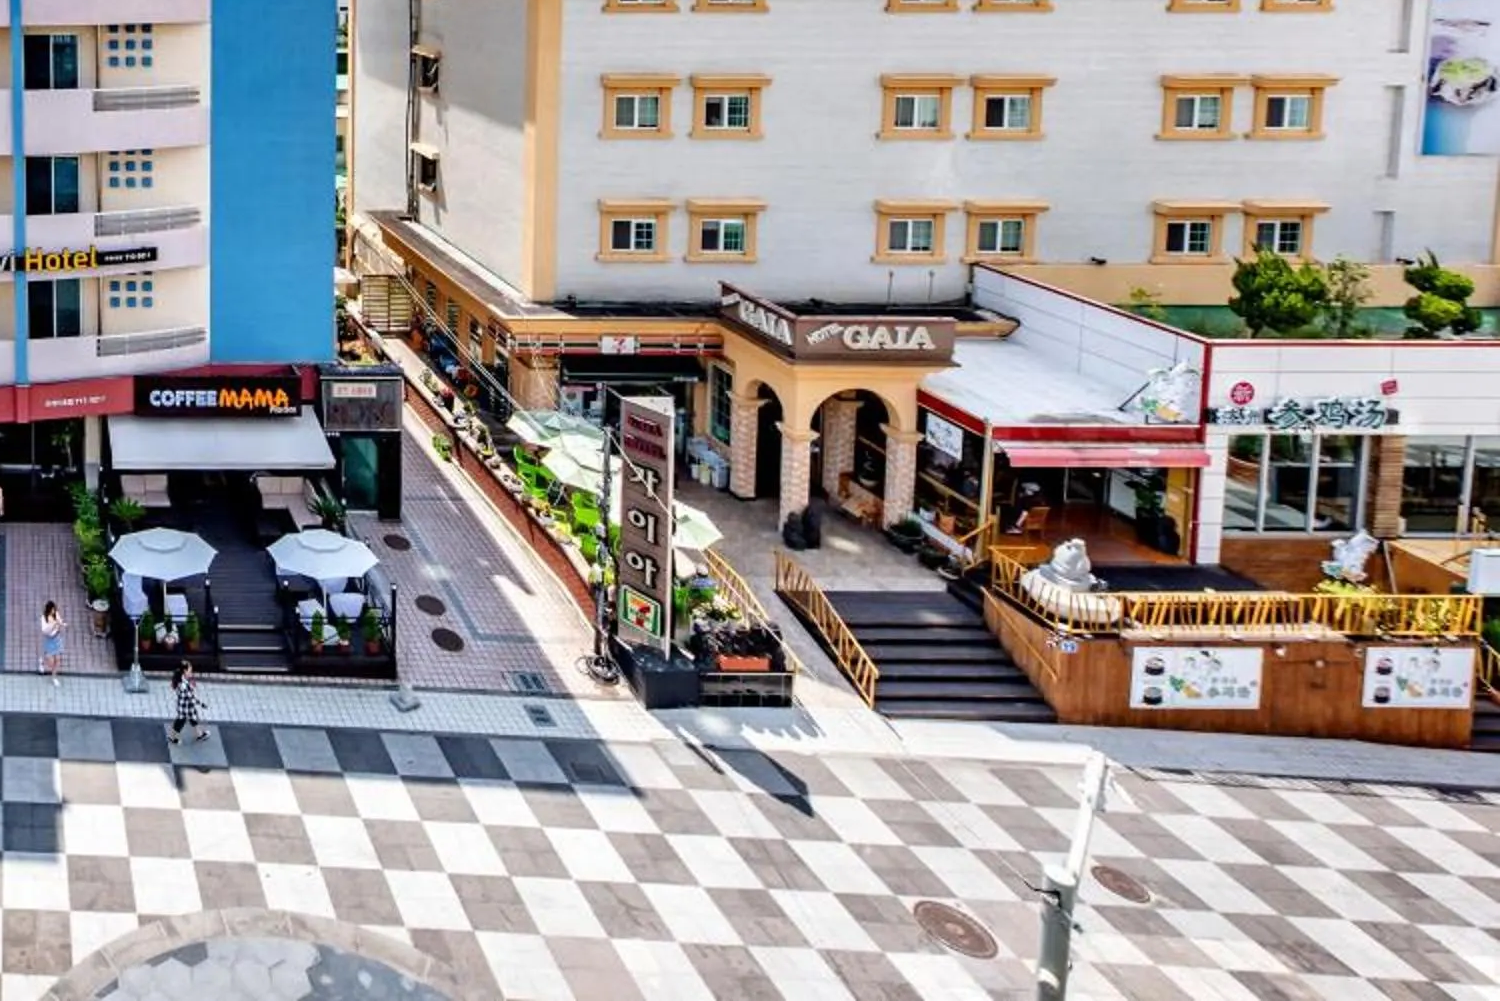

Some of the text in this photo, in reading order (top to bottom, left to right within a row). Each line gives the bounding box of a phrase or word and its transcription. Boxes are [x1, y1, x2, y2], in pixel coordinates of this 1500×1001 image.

[24, 245, 98, 273] Hotel
[842, 324, 936, 350] GAIA
[150, 388, 289, 410] COFFEE MAMA
